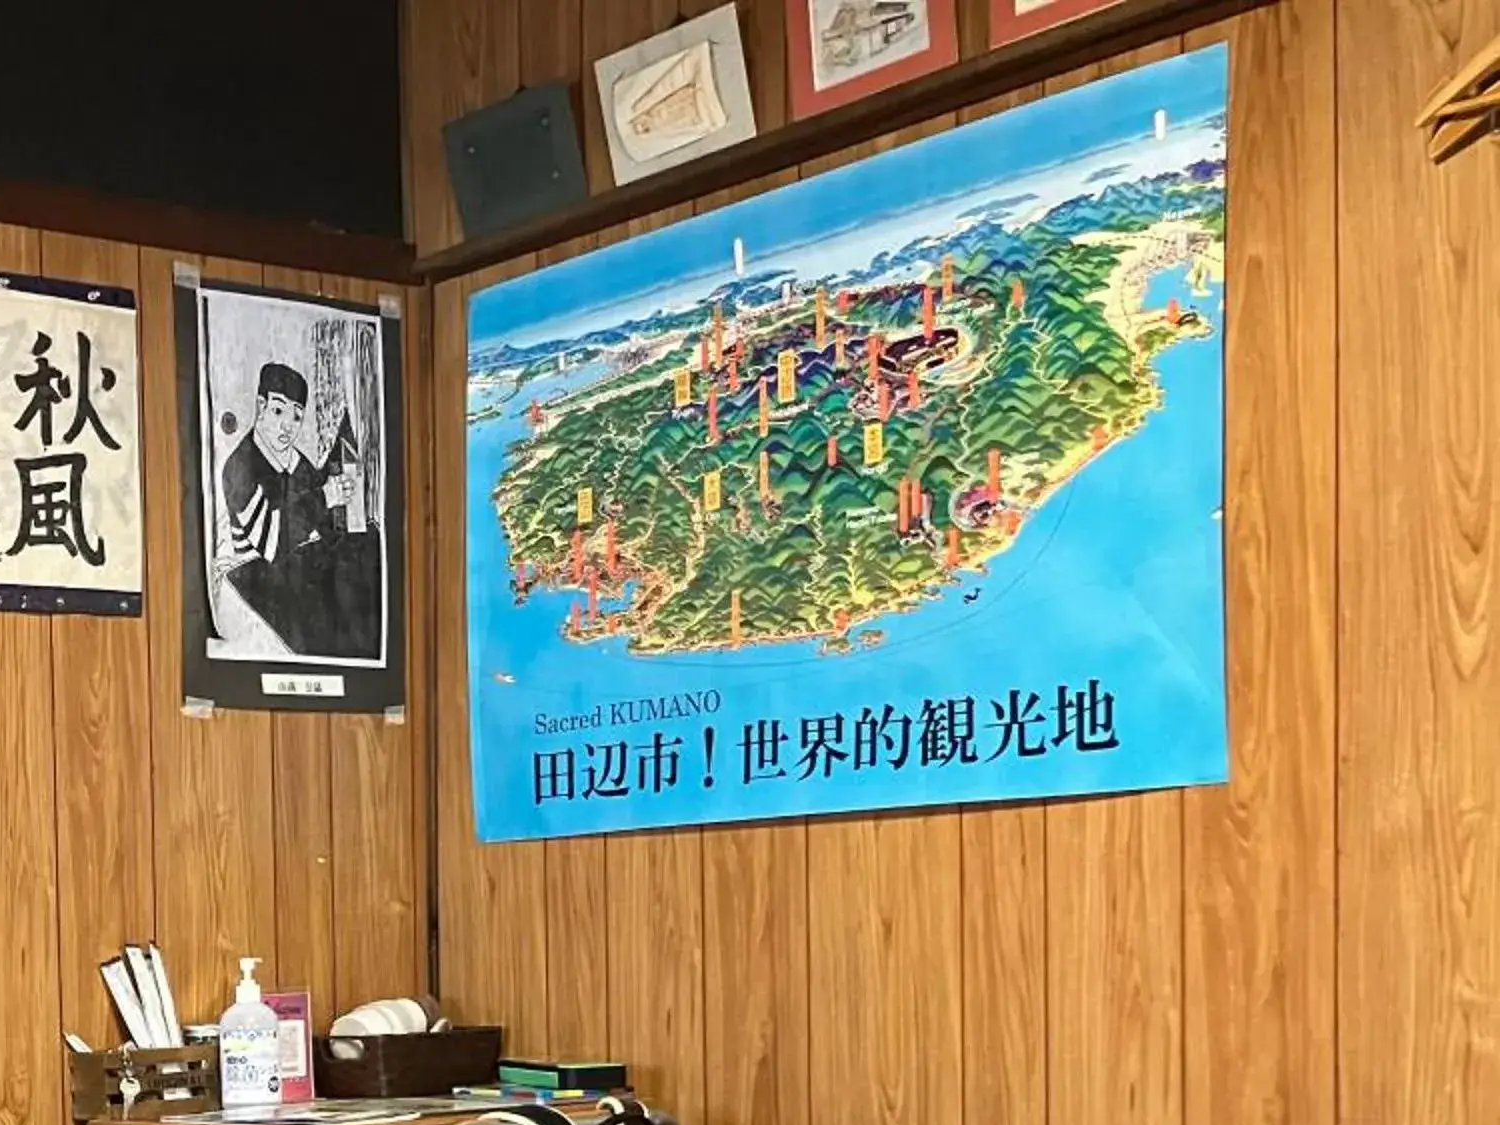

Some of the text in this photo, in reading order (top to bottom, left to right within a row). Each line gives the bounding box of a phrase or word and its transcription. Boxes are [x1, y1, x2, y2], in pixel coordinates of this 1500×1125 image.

[6, 330, 122, 567] 秋風
[534, 689, 722, 736] Sacred KUMANO
